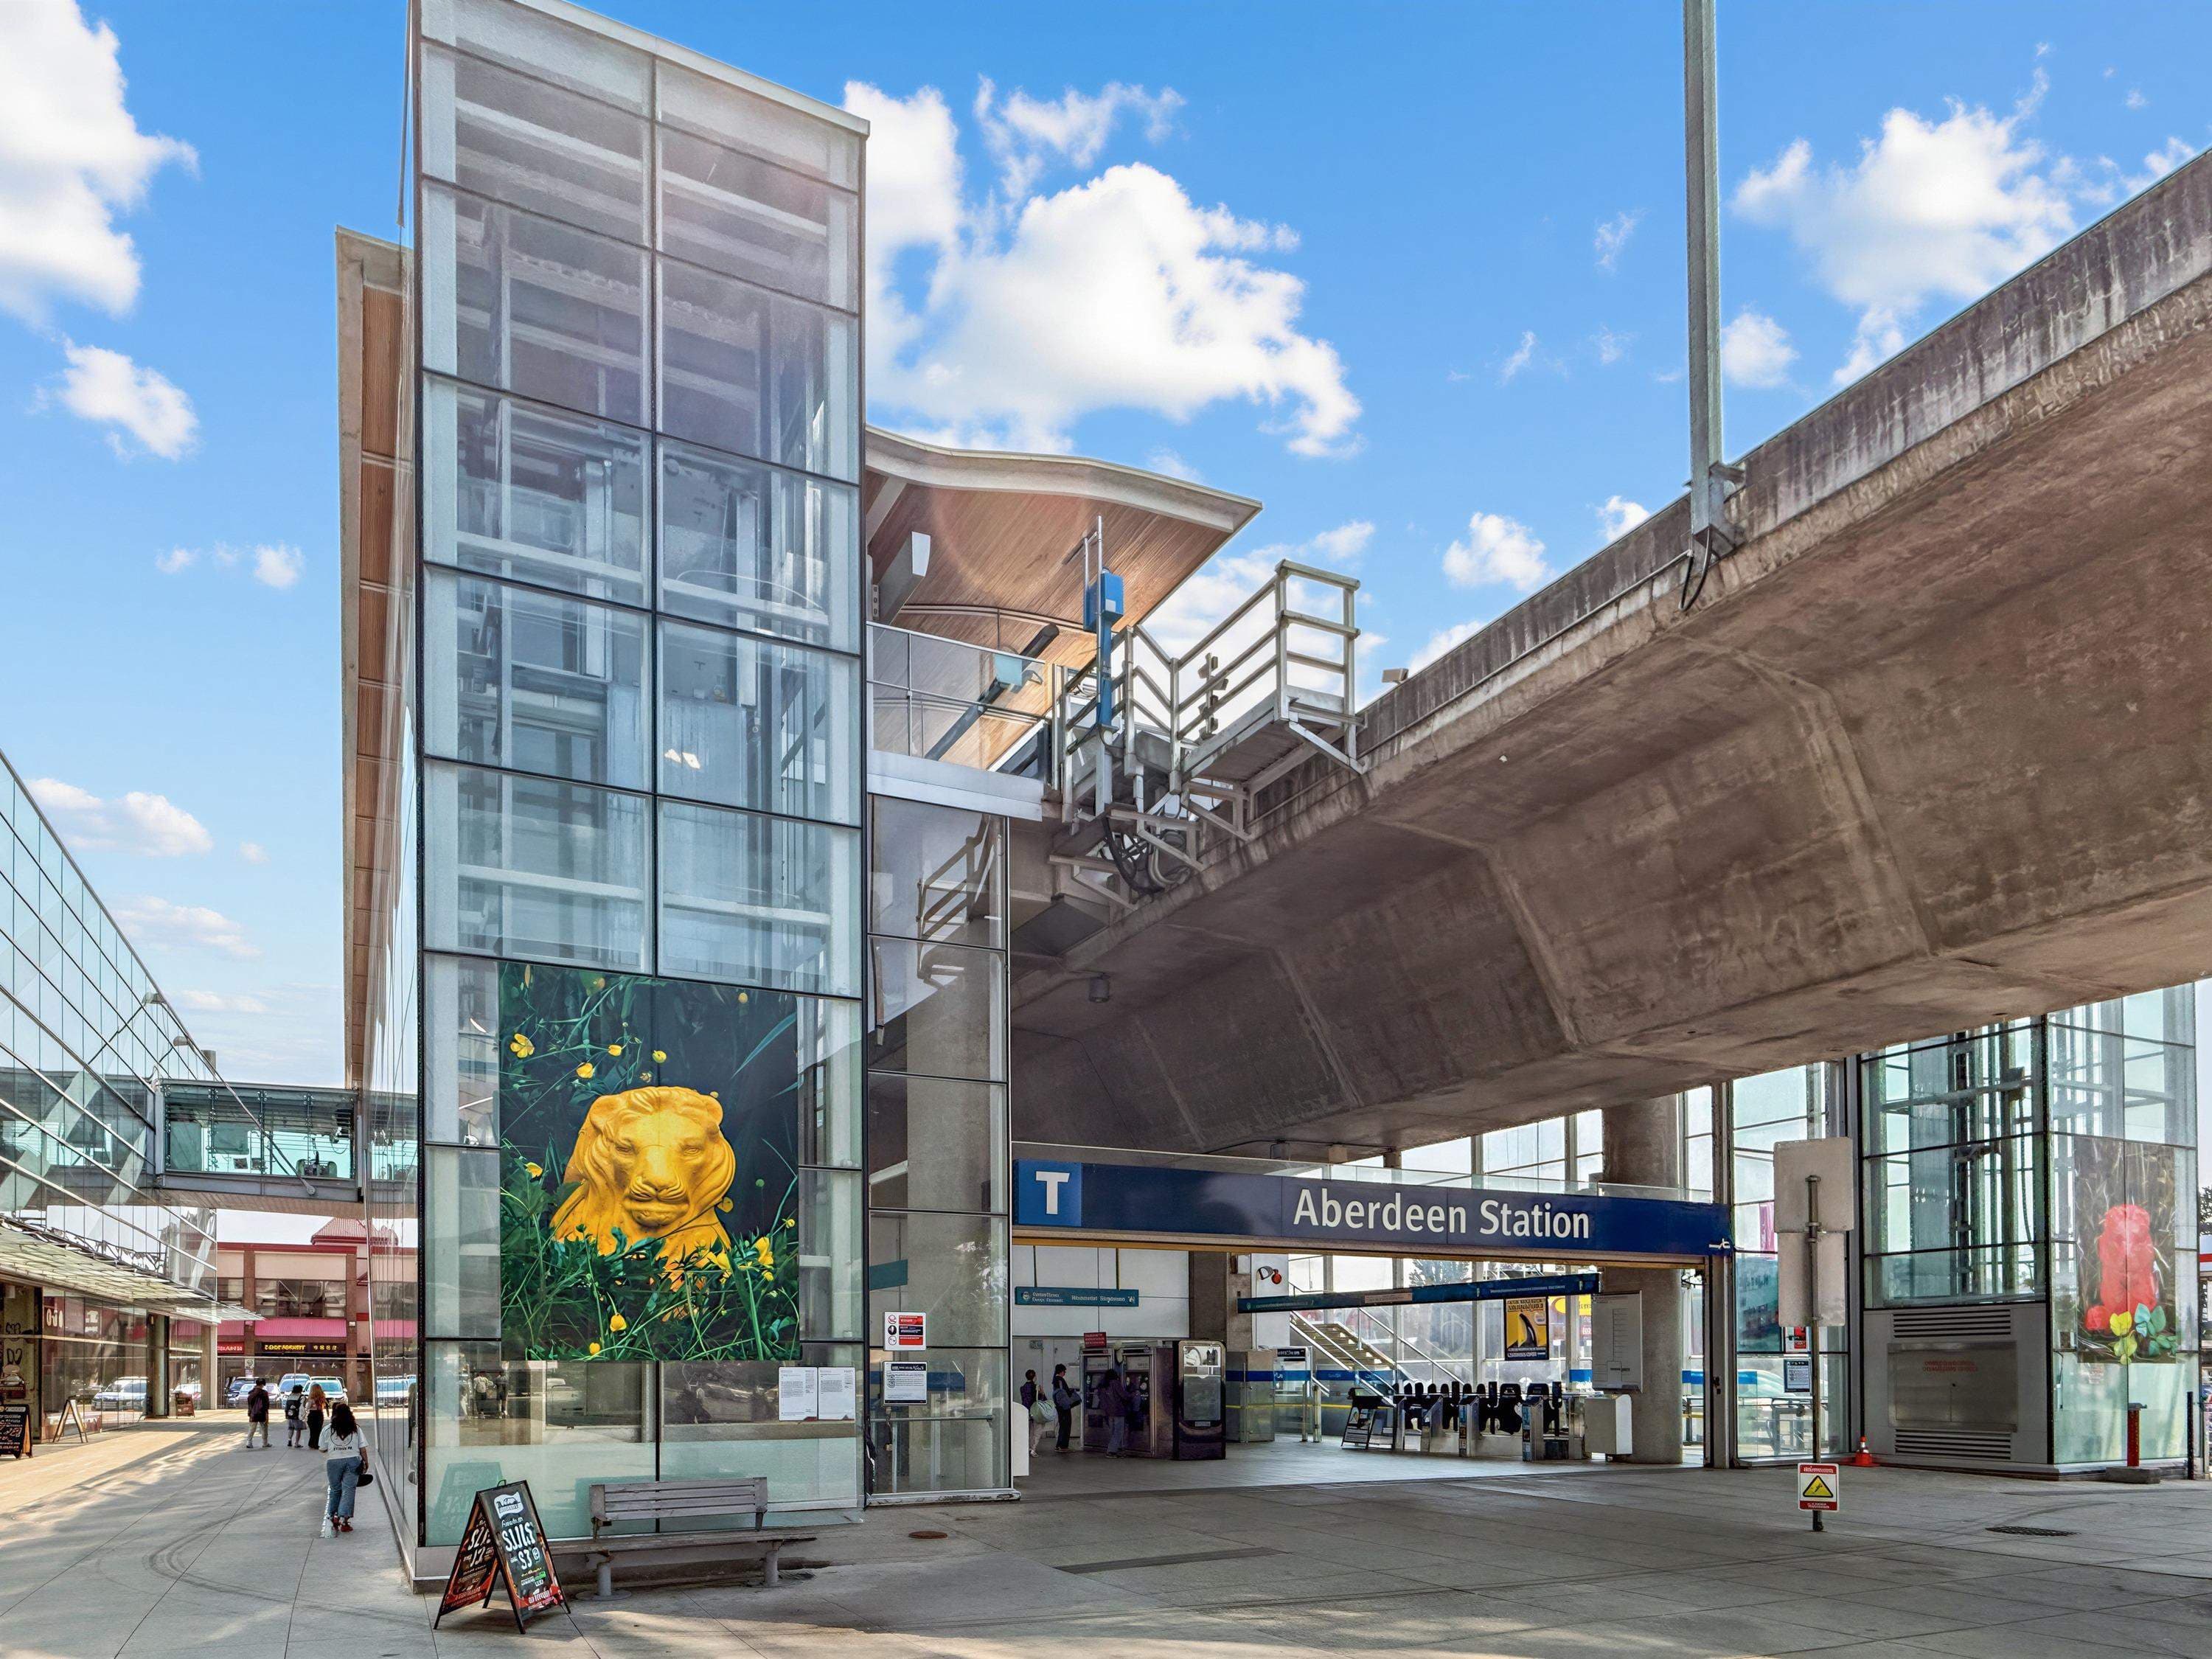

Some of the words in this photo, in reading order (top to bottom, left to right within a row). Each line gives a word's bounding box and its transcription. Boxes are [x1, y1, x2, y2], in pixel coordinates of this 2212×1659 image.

[1035, 1170, 1071, 1215] T
[1293, 1187, 1467, 1234] Aberdeen
[1479, 1199, 1590, 1239] Station
